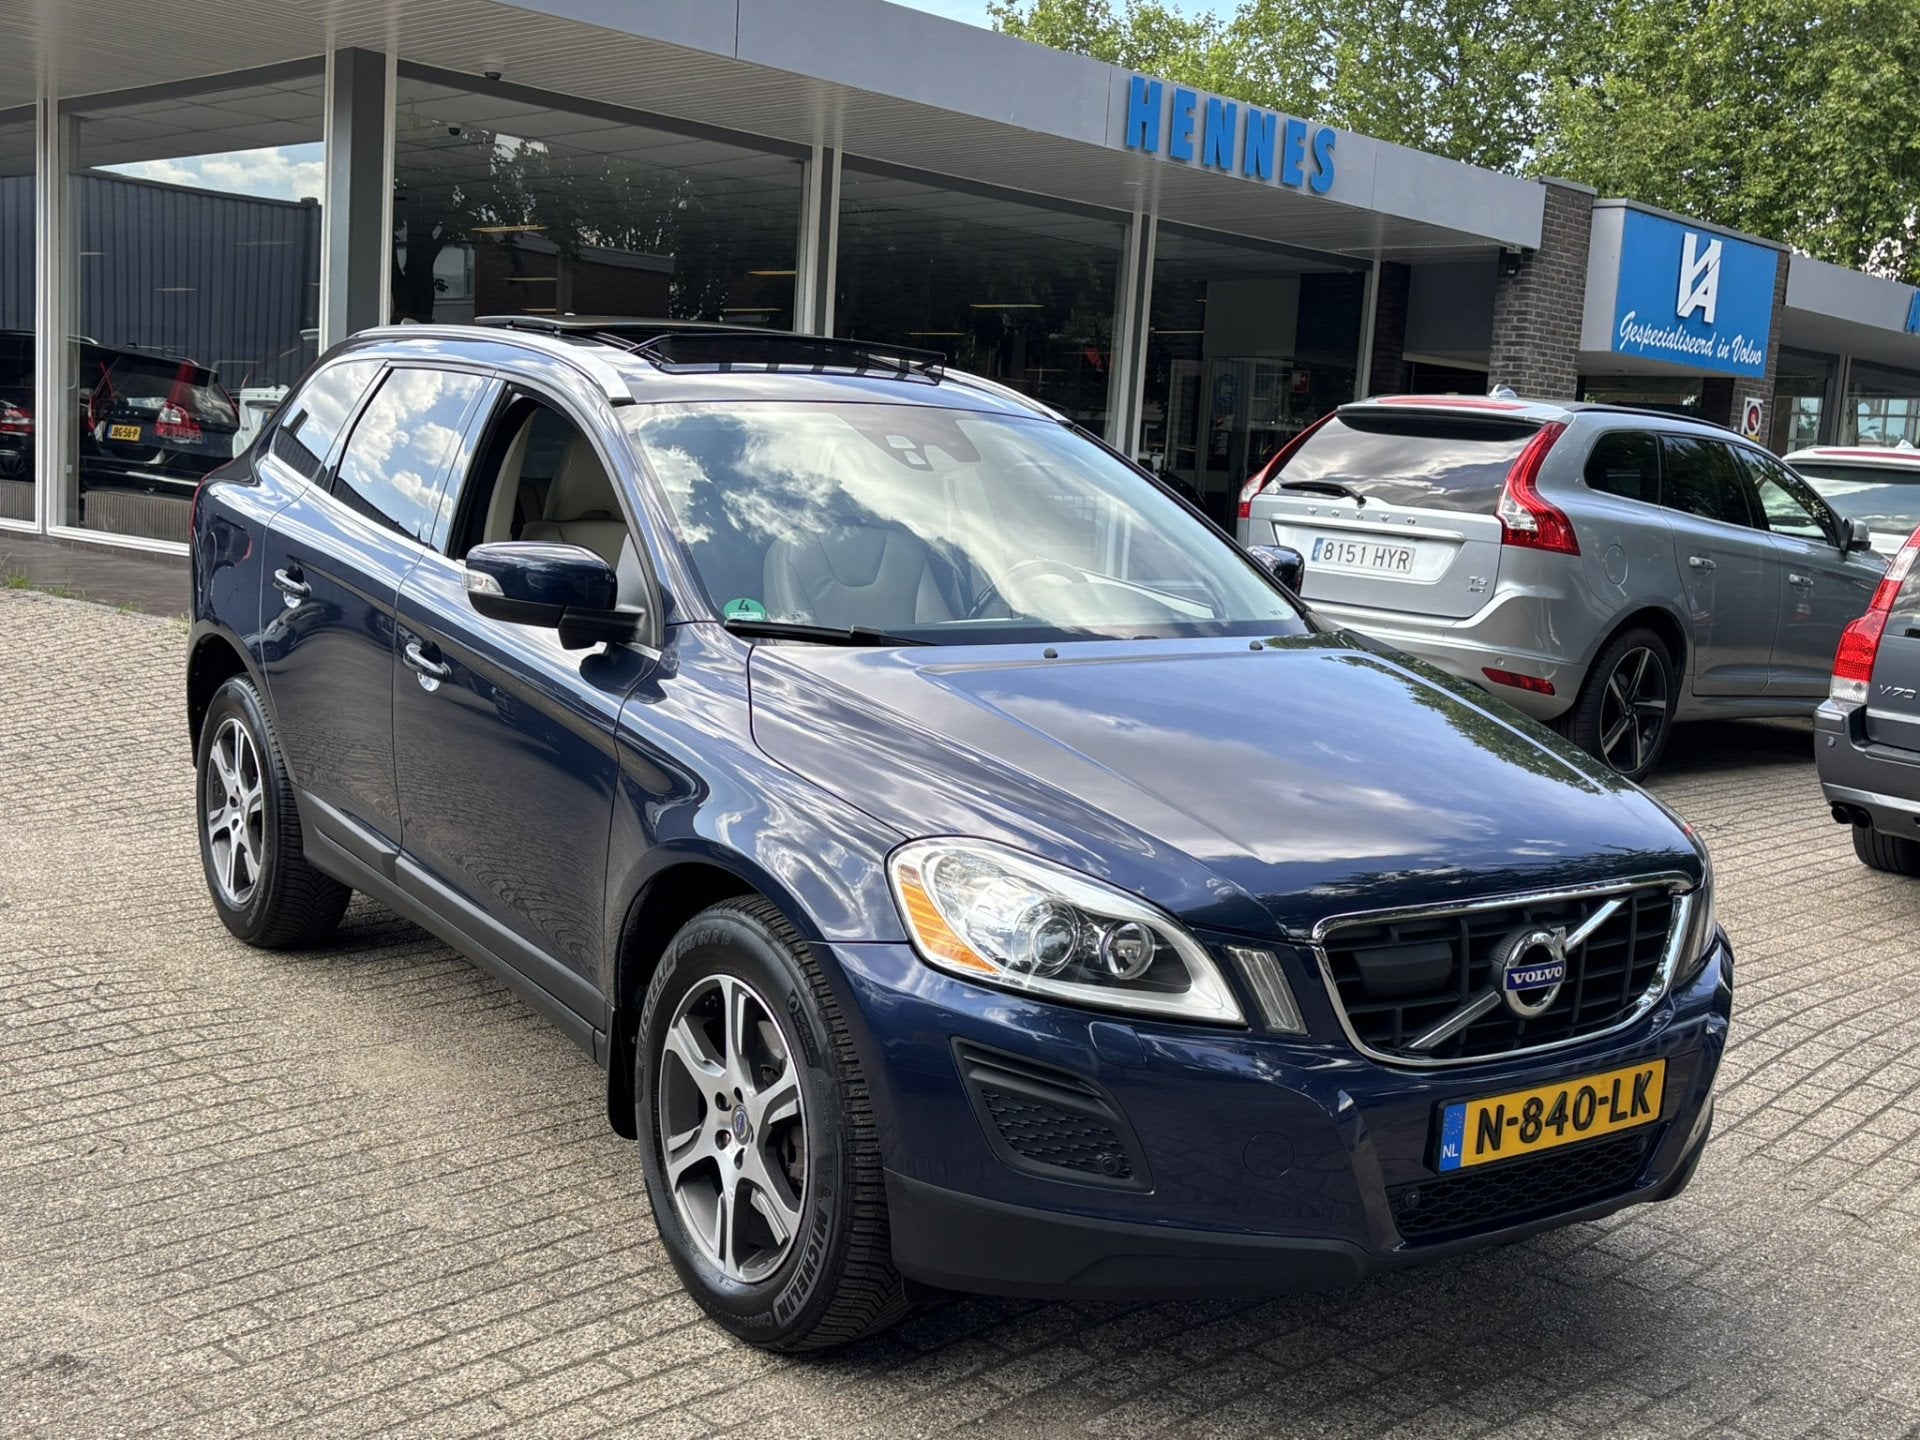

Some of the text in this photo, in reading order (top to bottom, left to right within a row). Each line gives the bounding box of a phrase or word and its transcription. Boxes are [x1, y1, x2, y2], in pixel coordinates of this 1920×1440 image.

[1126, 75, 1336, 194] HENNES
[1619, 310, 1762, 365] Gespecialiseerd in Volvo
[1323, 541, 1410, 571] 8151 HYR
[738, 599, 750, 612] 4
[1879, 684, 1917, 700] V70
[1511, 966, 1562, 984] VOLVO
[1475, 1070, 1653, 1155] N-840-LK
[1442, 1143, 1459, 1159] NL
[776, 1206, 829, 1322] MICHELIN
